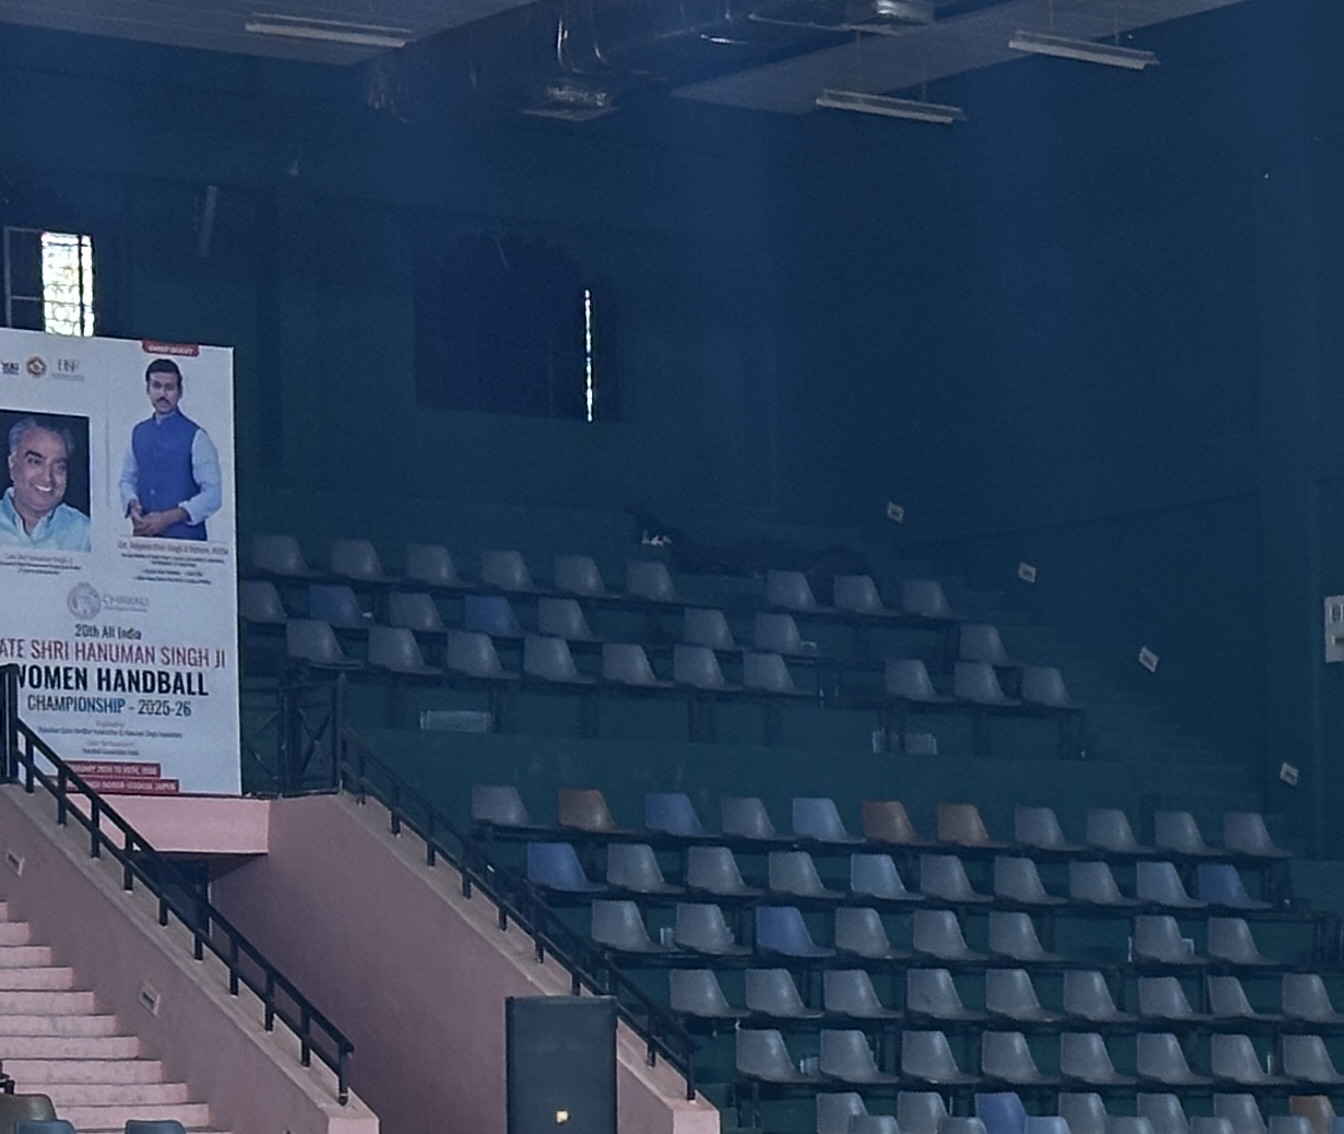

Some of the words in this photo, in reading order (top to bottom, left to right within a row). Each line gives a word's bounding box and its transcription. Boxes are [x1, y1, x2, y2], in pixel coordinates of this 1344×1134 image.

[75, 624, 99, 639] 20th
[101, 626, 115, 639] All
[118, 627, 142, 640] India
[31, 639, 69, 661] SHRI
[75, 642, 155, 666] HANUMAN
[161, 648, 209, 668] SINGH
[214, 650, 226, 668] JI
[97, 667, 210, 696] HANDBALL
[27, 694, 126, 714] CHAMPIONSHIP
[137, 699, 192, 717] 2025-26
